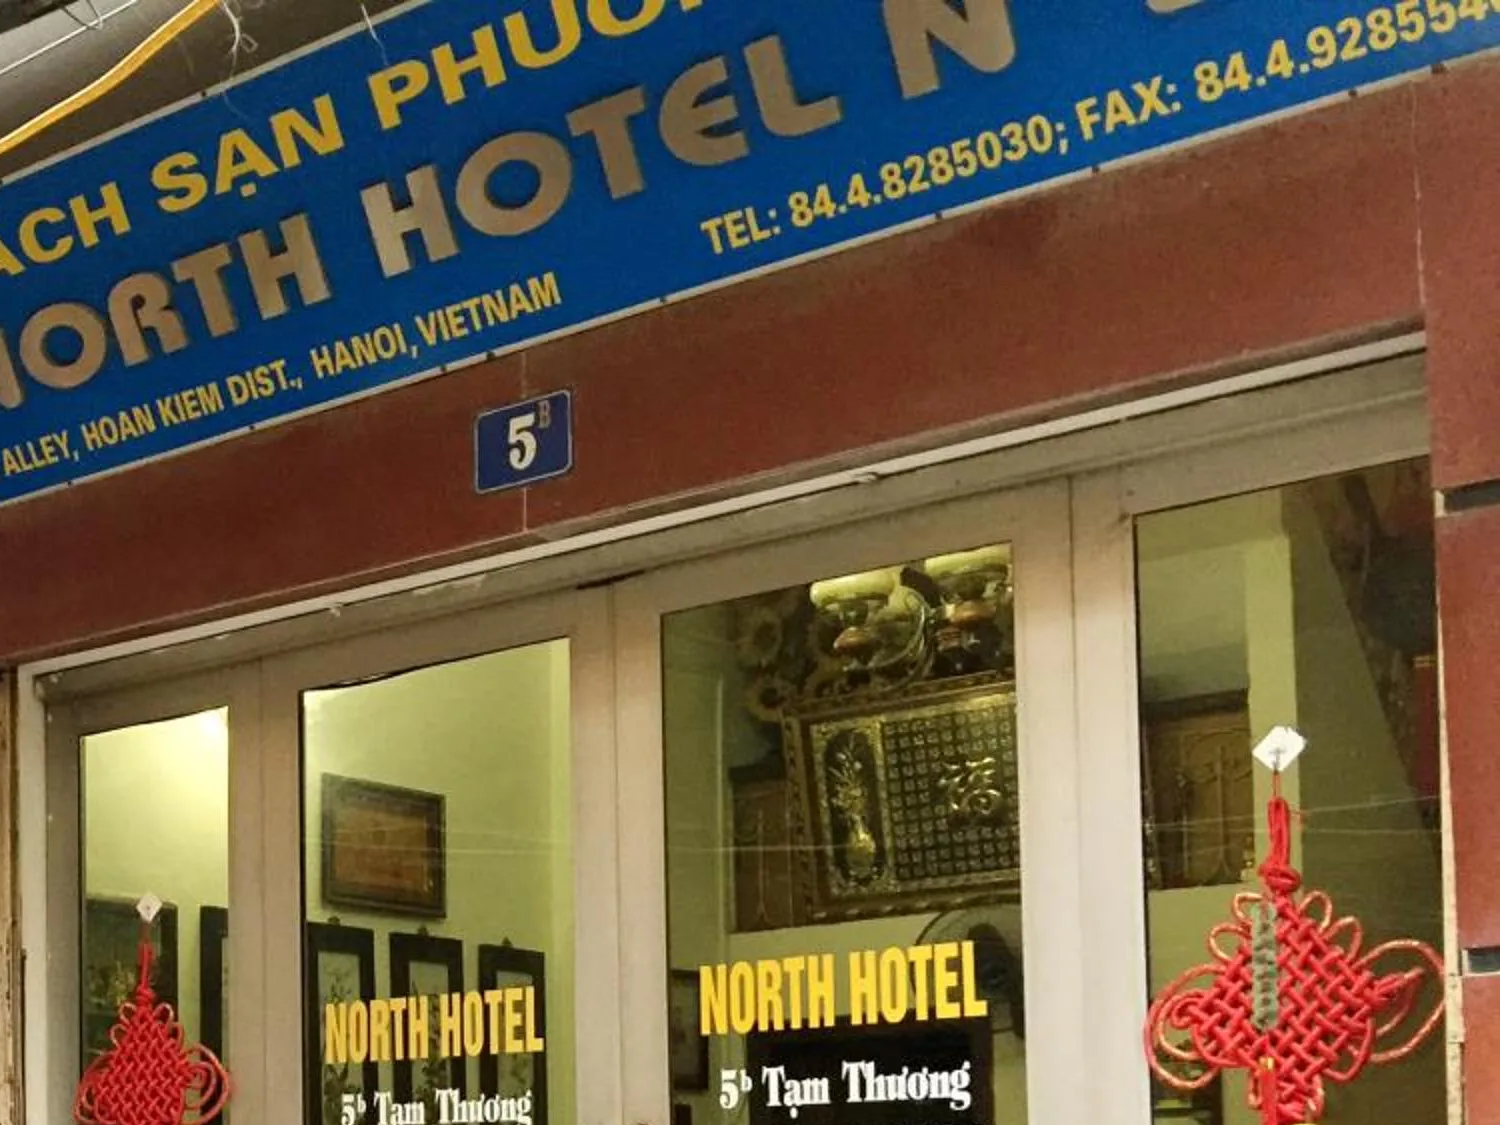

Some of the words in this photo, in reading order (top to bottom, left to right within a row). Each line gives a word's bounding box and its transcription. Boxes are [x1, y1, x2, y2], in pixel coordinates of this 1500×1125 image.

[151, 94, 345, 214] SẠN
[361, 33, 843, 277] HOTEL
[700, 206, 781, 255] TEL:
[788, 115, 1068, 228] 84.4.8285030;
[1074, 75, 1182, 141] FAX:
[2, 430, 79, 478] ALLEY,
[81, 403, 156, 451] HOAN
[156, 383, 224, 429] KIEM
[311, 323, 417, 379] HANOI,
[417, 272, 562, 348] VIETNAM
[325, 996, 429, 1064] NORTH
[440, 985, 544, 1058] HOTEL
[700, 954, 836, 1037] NORTH
[849, 940, 988, 1025] HOTEL
[719, 1068, 753, 1110] 5b
[762, 1064, 831, 1119] Tạm
[841, 1060, 972, 1111] Thương
